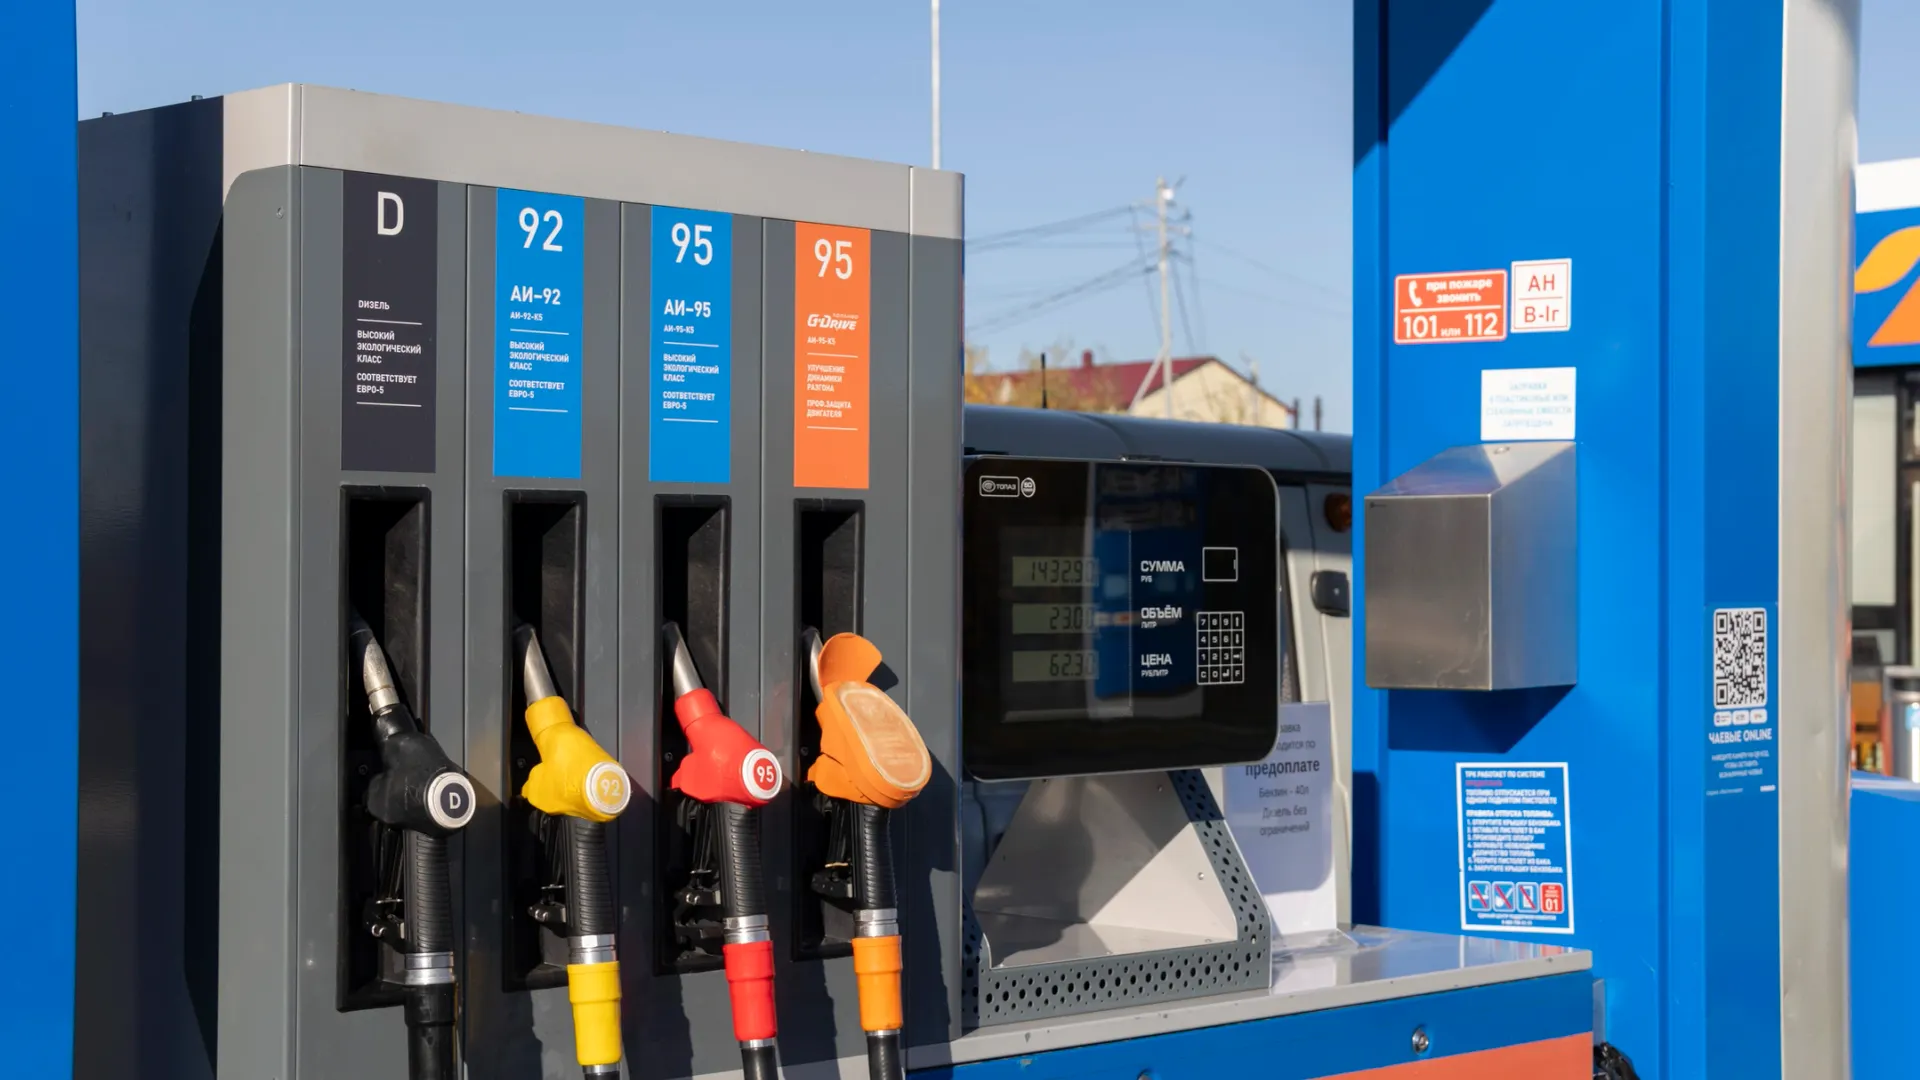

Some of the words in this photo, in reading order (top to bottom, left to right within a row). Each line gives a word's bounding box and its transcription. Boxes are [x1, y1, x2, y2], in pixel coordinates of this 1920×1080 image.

[377, 191, 404, 236] D
[518, 206, 563, 252] 92
[671, 222, 713, 266] 95
[814, 238, 853, 280] 95
[1426, 281, 1447, 292] при
[1449, 278, 1492, 290] пожаре
[510, 285, 561, 305] АИ-92
[1437, 293, 1481, 304] звонить
[664, 299, 711, 318] АИ-95
[1403, 315, 1437, 338] 101
[1441, 328, 1461, 337] или
[1465, 313, 1498, 336] 112
[357, 330, 395, 340] ВЫСОКИЙ
[357, 343, 422, 354] ЭКОЛОГИЧЕСКИЙ
[509, 341, 544, 350] ВЫСОКИЙ
[357, 354, 382, 364] КЛАСС
[509, 351, 569, 362] ЭКОЛОГИЧЕСКИЙ
[663, 354, 696, 362] ВЫСОКИЙ
[509, 362, 533, 371] КЛАСС
[663, 364, 719, 374] ЭКОЛОГИЧЕСКИЙ
[356, 373, 418, 383] СООТВЕТСТВУЕТ
[663, 374, 685, 382] КЛАСС
[356, 385, 384, 394] ЕВРО-5
[509, 380, 565, 390] СООТВЕТСТВУЕТ
[509, 390, 535, 398] ЕВРО-5
[663, 391, 715, 401] СООТВЕТСТВУЕТ
[663, 401, 687, 410] ЕВРО-5
[1141, 561, 1185, 573] СУММА
[1141, 605, 1182, 619] ОБЪЁМ
[1141, 654, 1172, 668] ЦЕНА
[1708, 730, 1742, 744] ЧАЕВЫЕ
[1743, 728, 1772, 742] ONLINE
[1305, 740, 1316, 749] по
[757, 766, 774, 783] 95
[1245, 760, 1320, 779] предоплате
[601, 778, 621, 797] 92
[1259, 788, 1288, 798] Бензин
[449, 792, 461, 809] D
[1293, 806, 1307, 816] без
[1260, 821, 1310, 836] ограничений
[1545, 898, 1558, 911] 01
